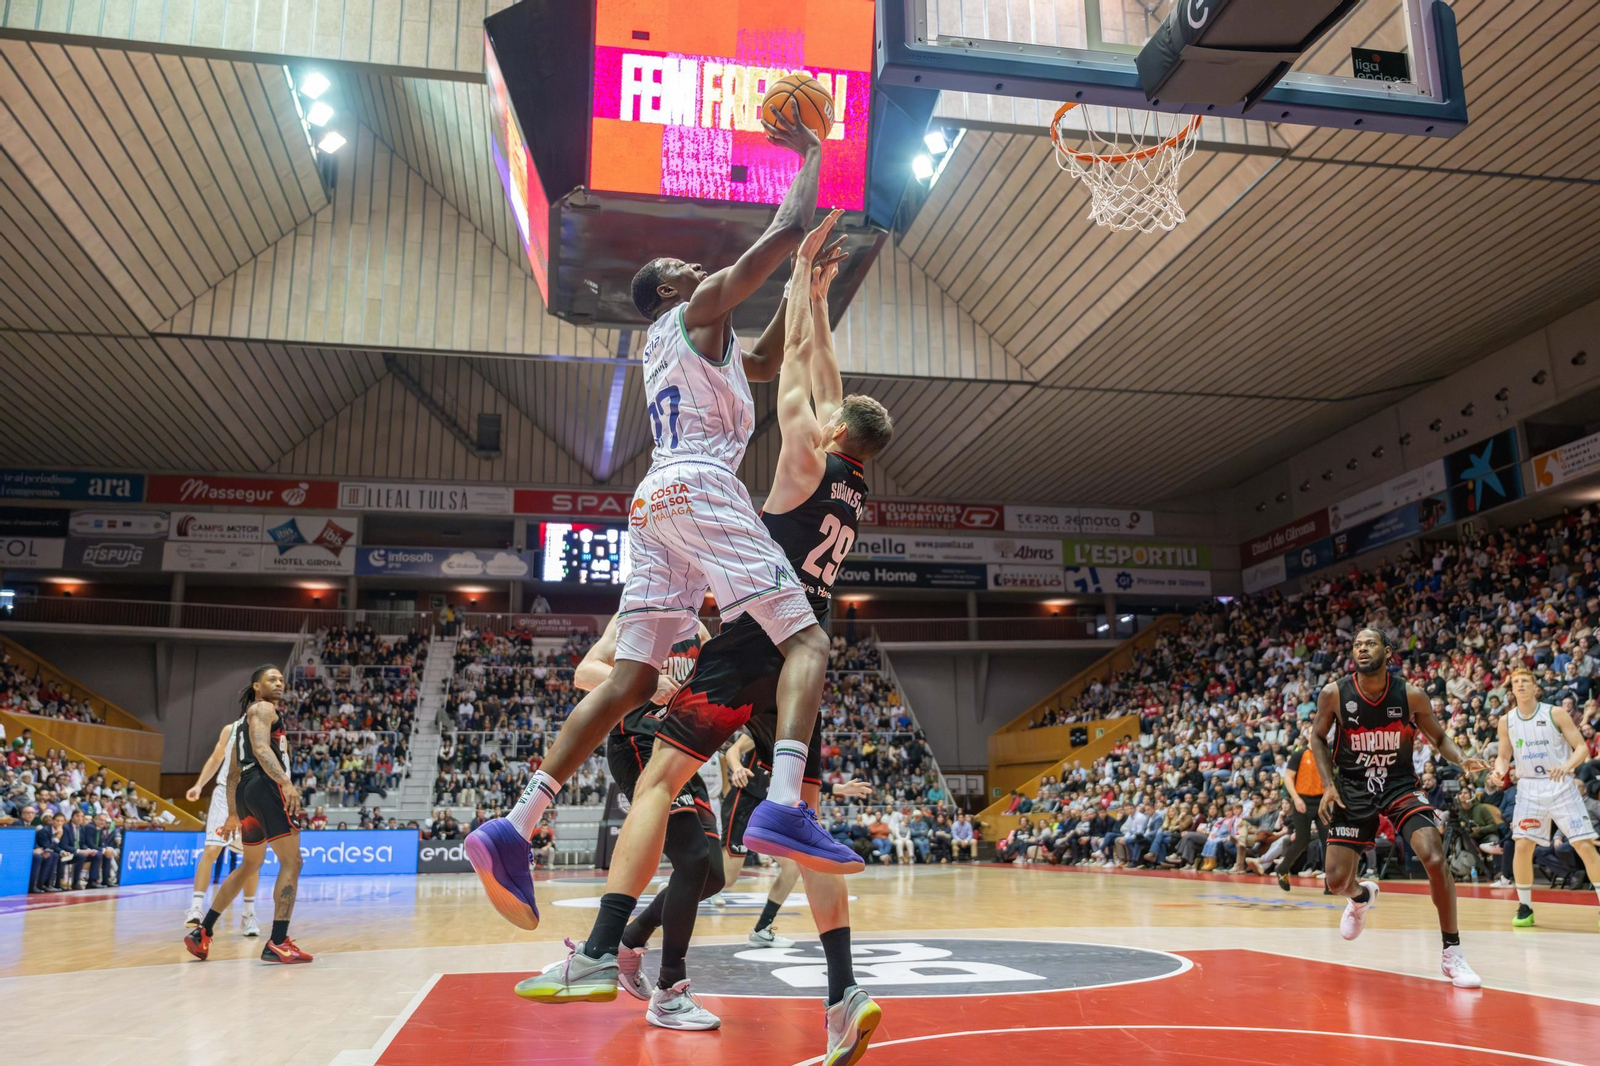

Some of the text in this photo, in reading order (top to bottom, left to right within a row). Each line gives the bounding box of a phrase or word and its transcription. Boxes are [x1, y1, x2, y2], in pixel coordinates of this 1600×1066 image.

[1355, 59, 1379, 72] liga
[88, 477, 131, 497] ara
[180, 478, 273, 502] Massegur
[650, 483, 690, 502] COSTA
[367, 489, 412, 509] LLEAL
[418, 489, 468, 511] TULSÀ
[651, 495, 692, 513] DEL SOL
[880, 503, 962, 514] EQUIPACIONS
[885, 512, 957, 522] ESPORTIVES
[191, 524, 260, 533] CAMPS MOTOR
[277, 527, 294, 540] ibis
[322, 527, 344, 546] ibis
[850, 537, 906, 554] nella
[1251, 536, 1274, 556] Diari
[1285, 521, 1316, 542] Girona
[83, 548, 143, 562] DISPUIG
[388, 551, 434, 562] infosoft
[801, 513, 855, 587] 29
[1013, 545, 1054, 560] Abras
[1073, 543, 1198, 567] L'ESPORTIU
[274, 557, 342, 567] HOTEL GIRONA
[837, 567, 871, 582] Kave
[874, 567, 918, 583] Home
[520, 617, 547, 627] girona
[1350, 730, 1401, 752] GIRONA
[1355, 752, 1397, 767] FIATC
[1534, 765, 1547, 775] 9
[1335, 826, 1360, 838] YOSOY
[127, 845, 158, 870] endesa
[160, 844, 189, 869] endesa
[299, 841, 393, 863] endesa
[420, 843, 470, 862] end
